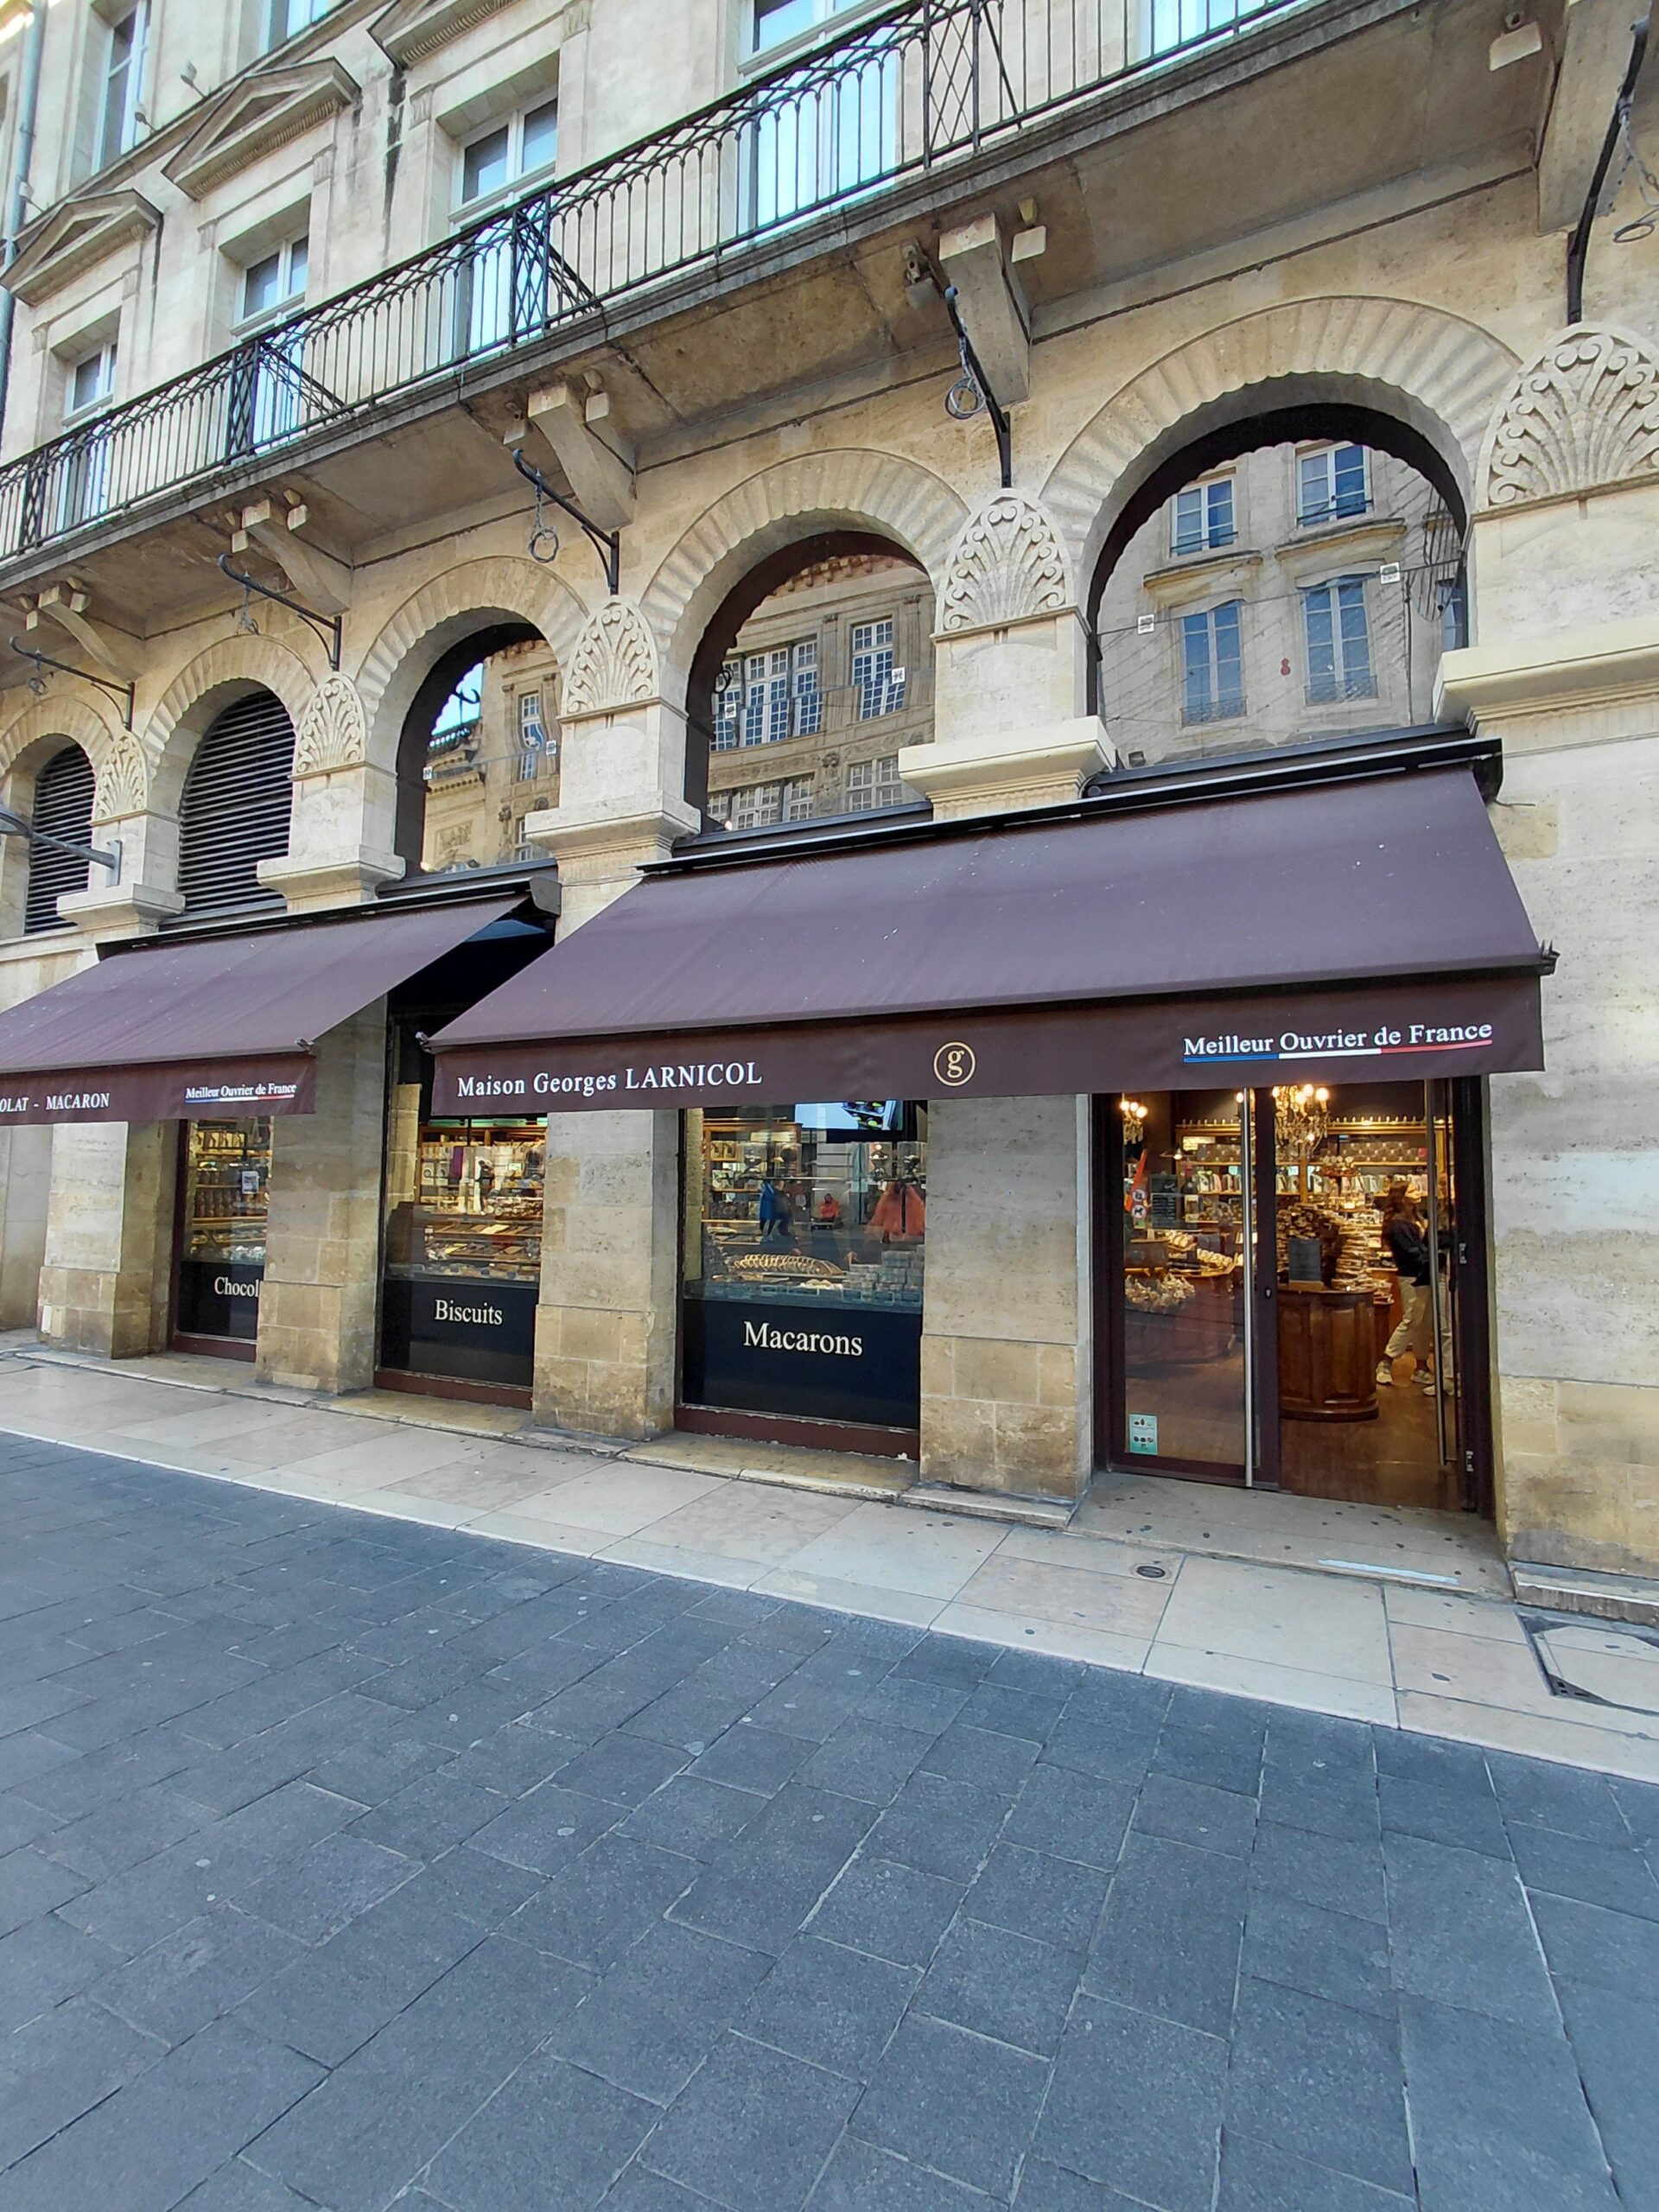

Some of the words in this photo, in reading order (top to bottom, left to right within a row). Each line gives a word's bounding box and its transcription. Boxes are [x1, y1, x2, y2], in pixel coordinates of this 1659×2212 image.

[1183, 1037, 1274, 1056] Meilleur
[1279, 1028, 1368, 1051] Ouvrier
[1374, 1027, 1402, 1046] de
[1408, 1024, 1494, 1044] France
[185, 1086, 219, 1099] Meilleur
[220, 1084, 254, 1096] Ouvrier
[255, 1084, 266, 1095] de
[268, 1083, 296, 1094] France
[457, 1075, 525, 1097] Maison
[533, 1072, 616, 1096] Georges
[625, 1062, 762, 1090] LARNICOL
[46, 1092, 111, 1110] MACARON
[434, 1299, 503, 1325] Biscuits
[743, 1320, 863, 1357] Macarons
